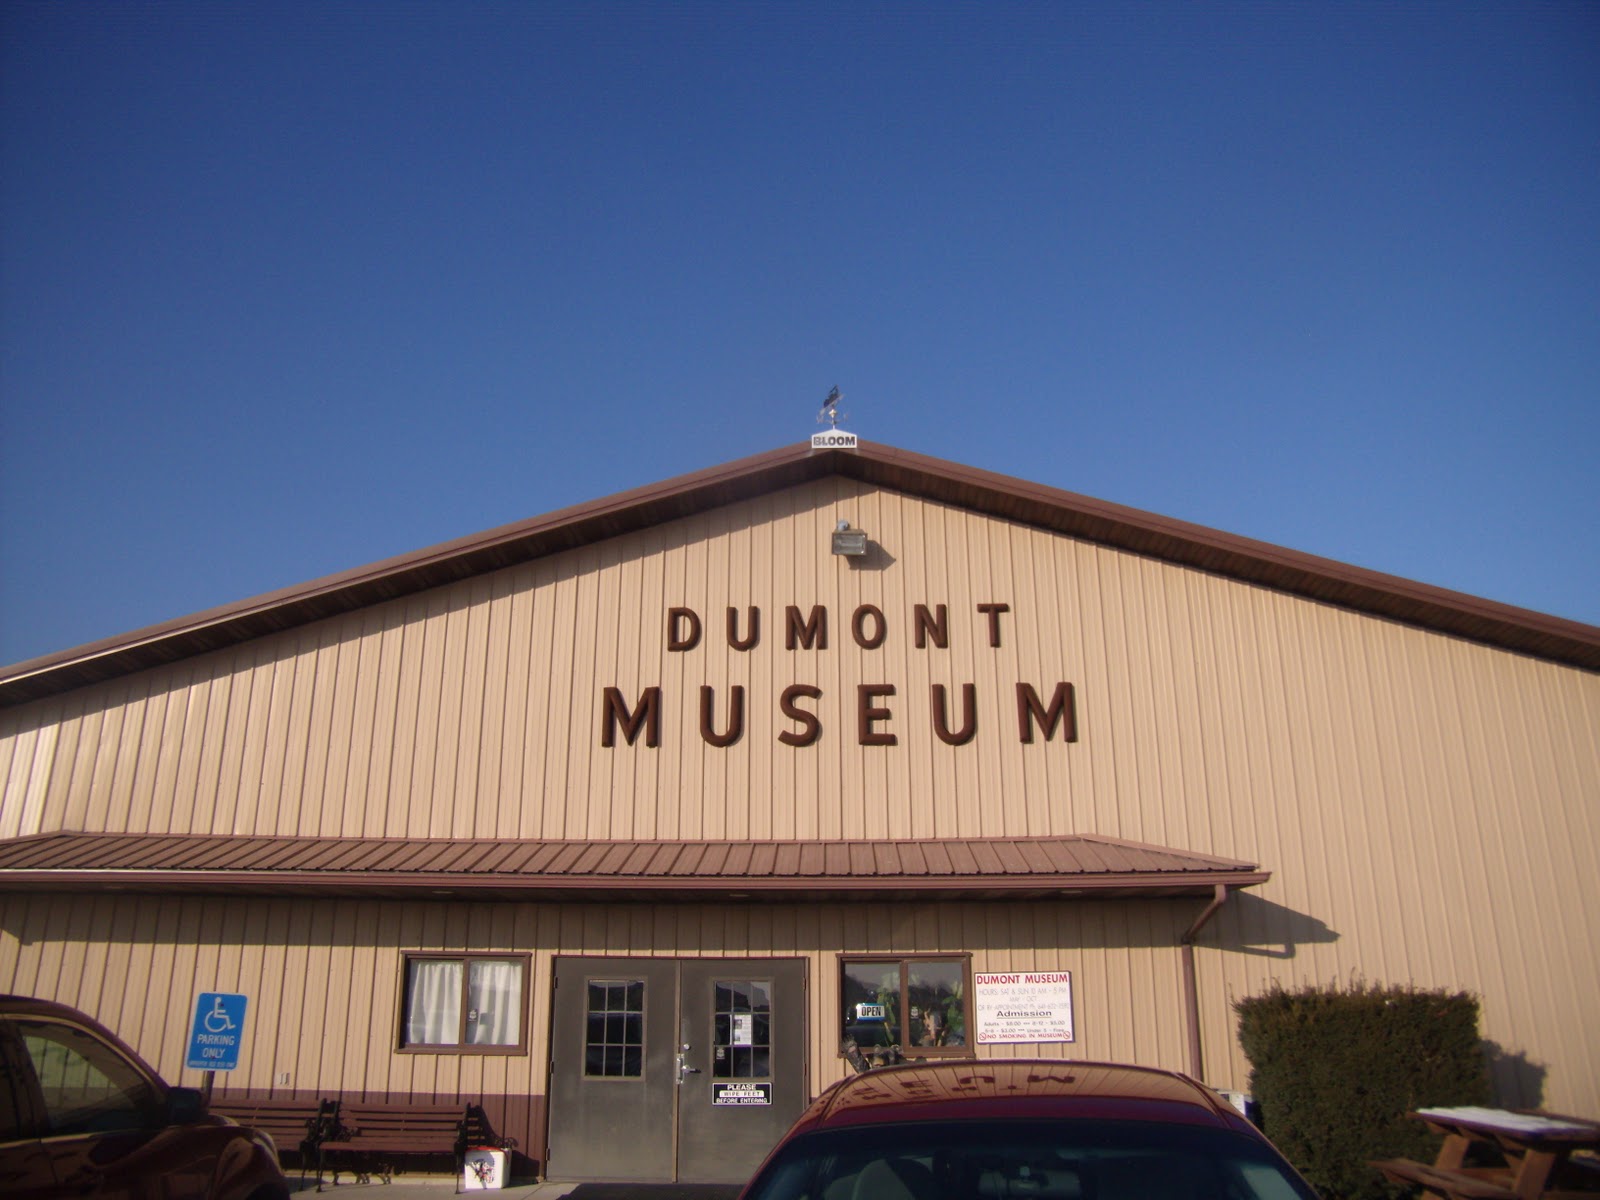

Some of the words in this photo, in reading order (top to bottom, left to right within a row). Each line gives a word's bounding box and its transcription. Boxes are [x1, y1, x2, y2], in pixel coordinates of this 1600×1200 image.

[813, 436, 856, 446] BLOOM
[667, 603, 1010, 652] DUMONT
[601, 681, 1078, 748] MUSEUM
[976, 975, 1020, 984] DUMONT
[1025, 974, 1068, 983] MUSEUM
[1017, 987, 1029, 995] SUN
[861, 1006, 881, 1017] OPEN
[197, 1033, 235, 1046] PARKING
[202, 1047, 226, 1059] ONLY
